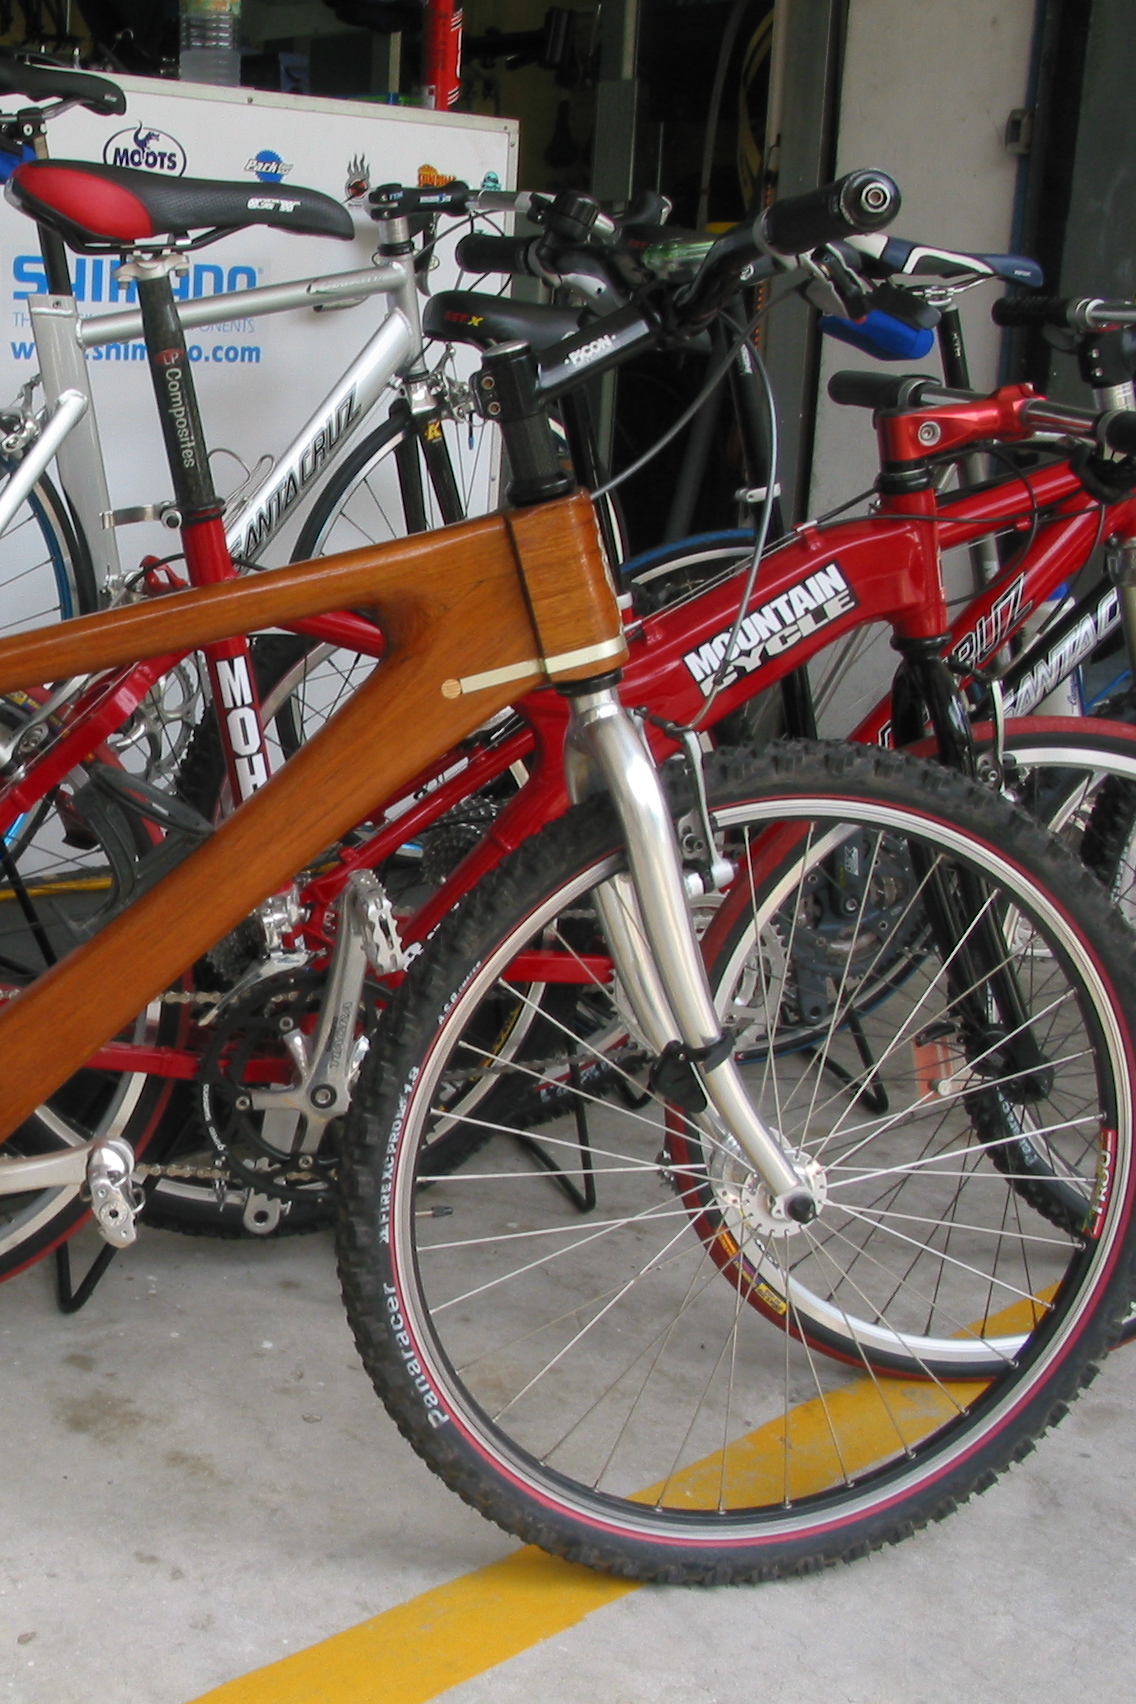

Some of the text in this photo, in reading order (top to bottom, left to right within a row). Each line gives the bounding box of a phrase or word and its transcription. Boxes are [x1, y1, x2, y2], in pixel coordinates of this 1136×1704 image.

[114, 147, 177, 171] MOOTS
[245, 159, 280, 174] Park
[11, 341, 261, 363] w.shimo.com
[166, 367, 196, 468] Composites
[298, 382, 362, 486] CRUZ
[683, 563, 847, 682] MOUNTAIN
[699, 589, 856, 697] CYCLE
[942, 571, 1033, 682] RUZ
[382, 1155, 395, 1181] XC
[387, 1117, 404, 1155] PRO
[379, 1181, 391, 1225] FIRE
[382, 1282, 451, 1430] Panaracer
